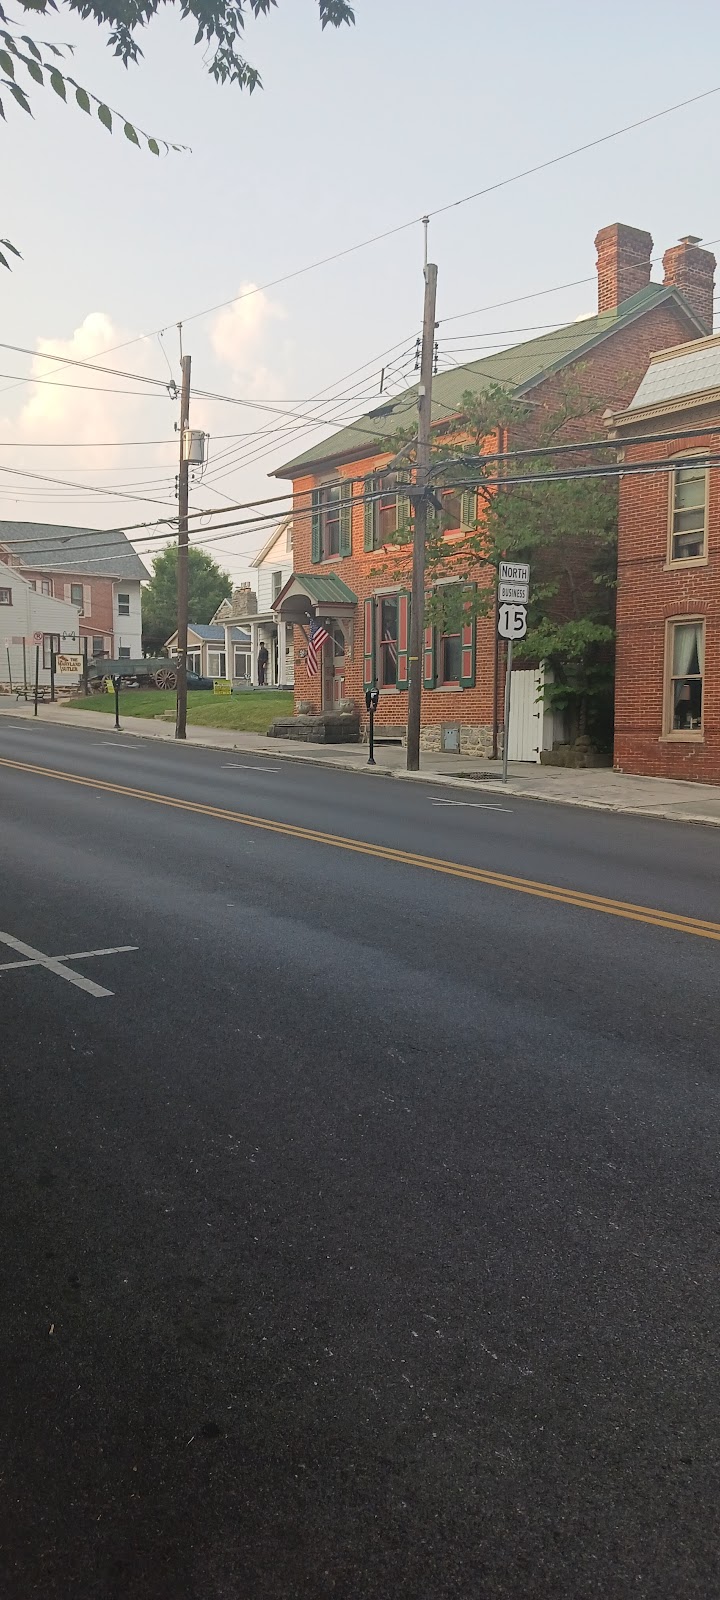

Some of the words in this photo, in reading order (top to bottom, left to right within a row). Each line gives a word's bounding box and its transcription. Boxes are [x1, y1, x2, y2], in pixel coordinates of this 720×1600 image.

[502, 565, 526, 579] NORTH
[502, 588, 525, 598] BUSINESS
[505, 611, 524, 630] 15
